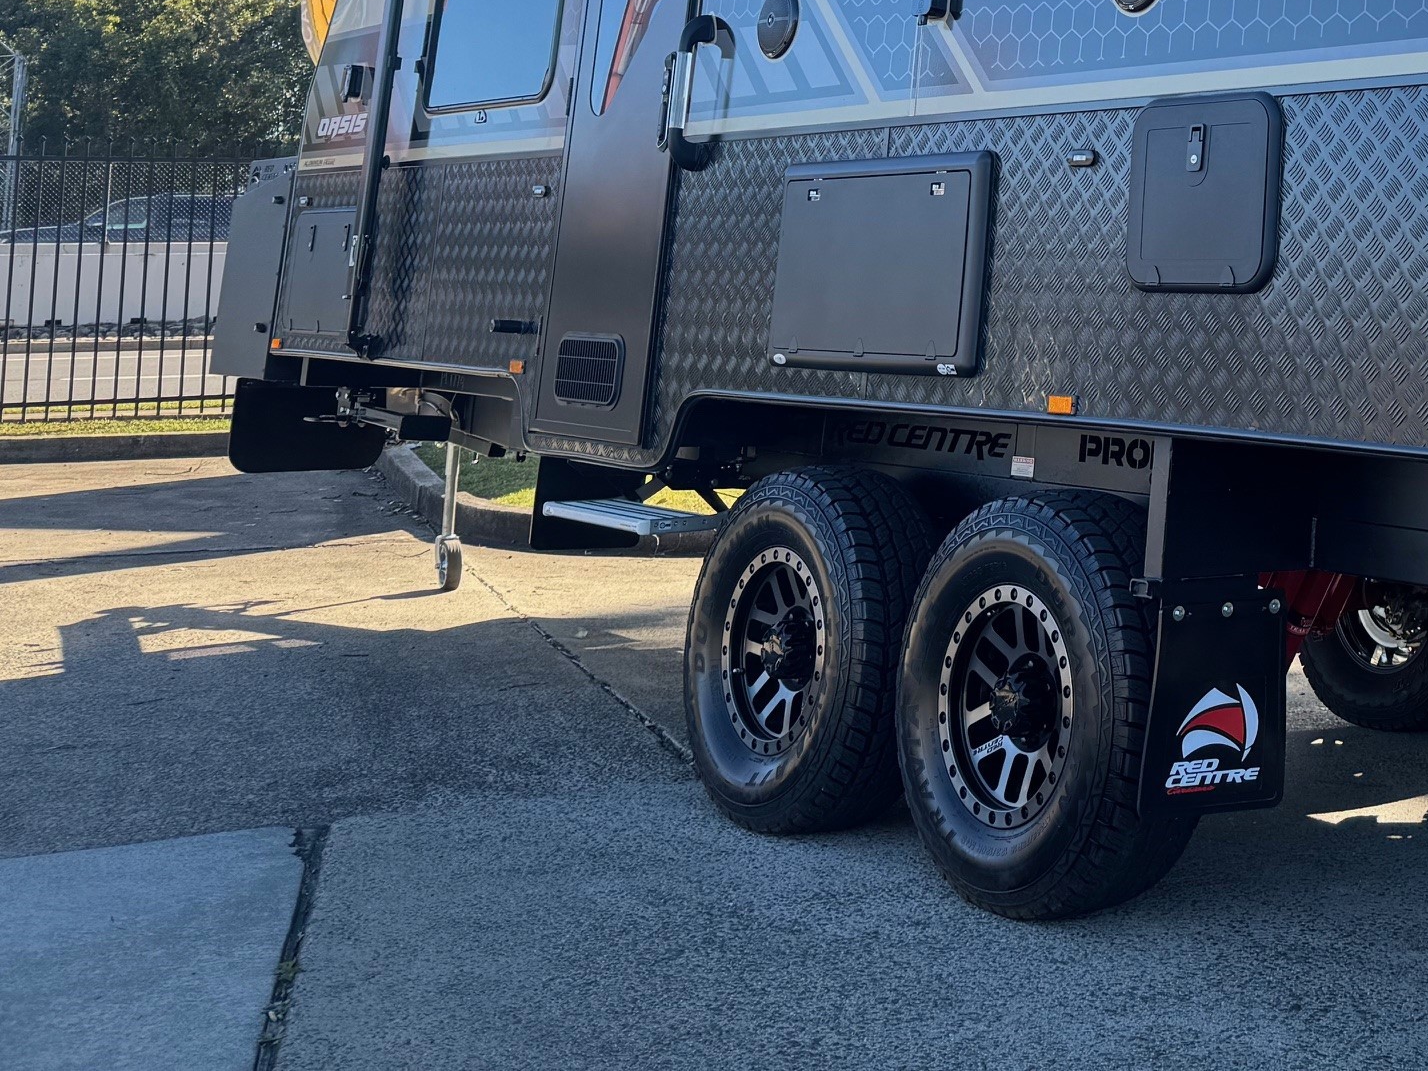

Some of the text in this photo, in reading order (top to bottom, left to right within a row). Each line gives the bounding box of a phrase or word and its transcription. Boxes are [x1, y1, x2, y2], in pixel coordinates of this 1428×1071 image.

[317, 112, 368, 140] OASIS
[829, 420, 1012, 461] RED CENTRE
[1078, 434, 1155, 470] PRO
[1165, 767, 1260, 788] CENTRE
[1169, 758, 1220, 776] RED
